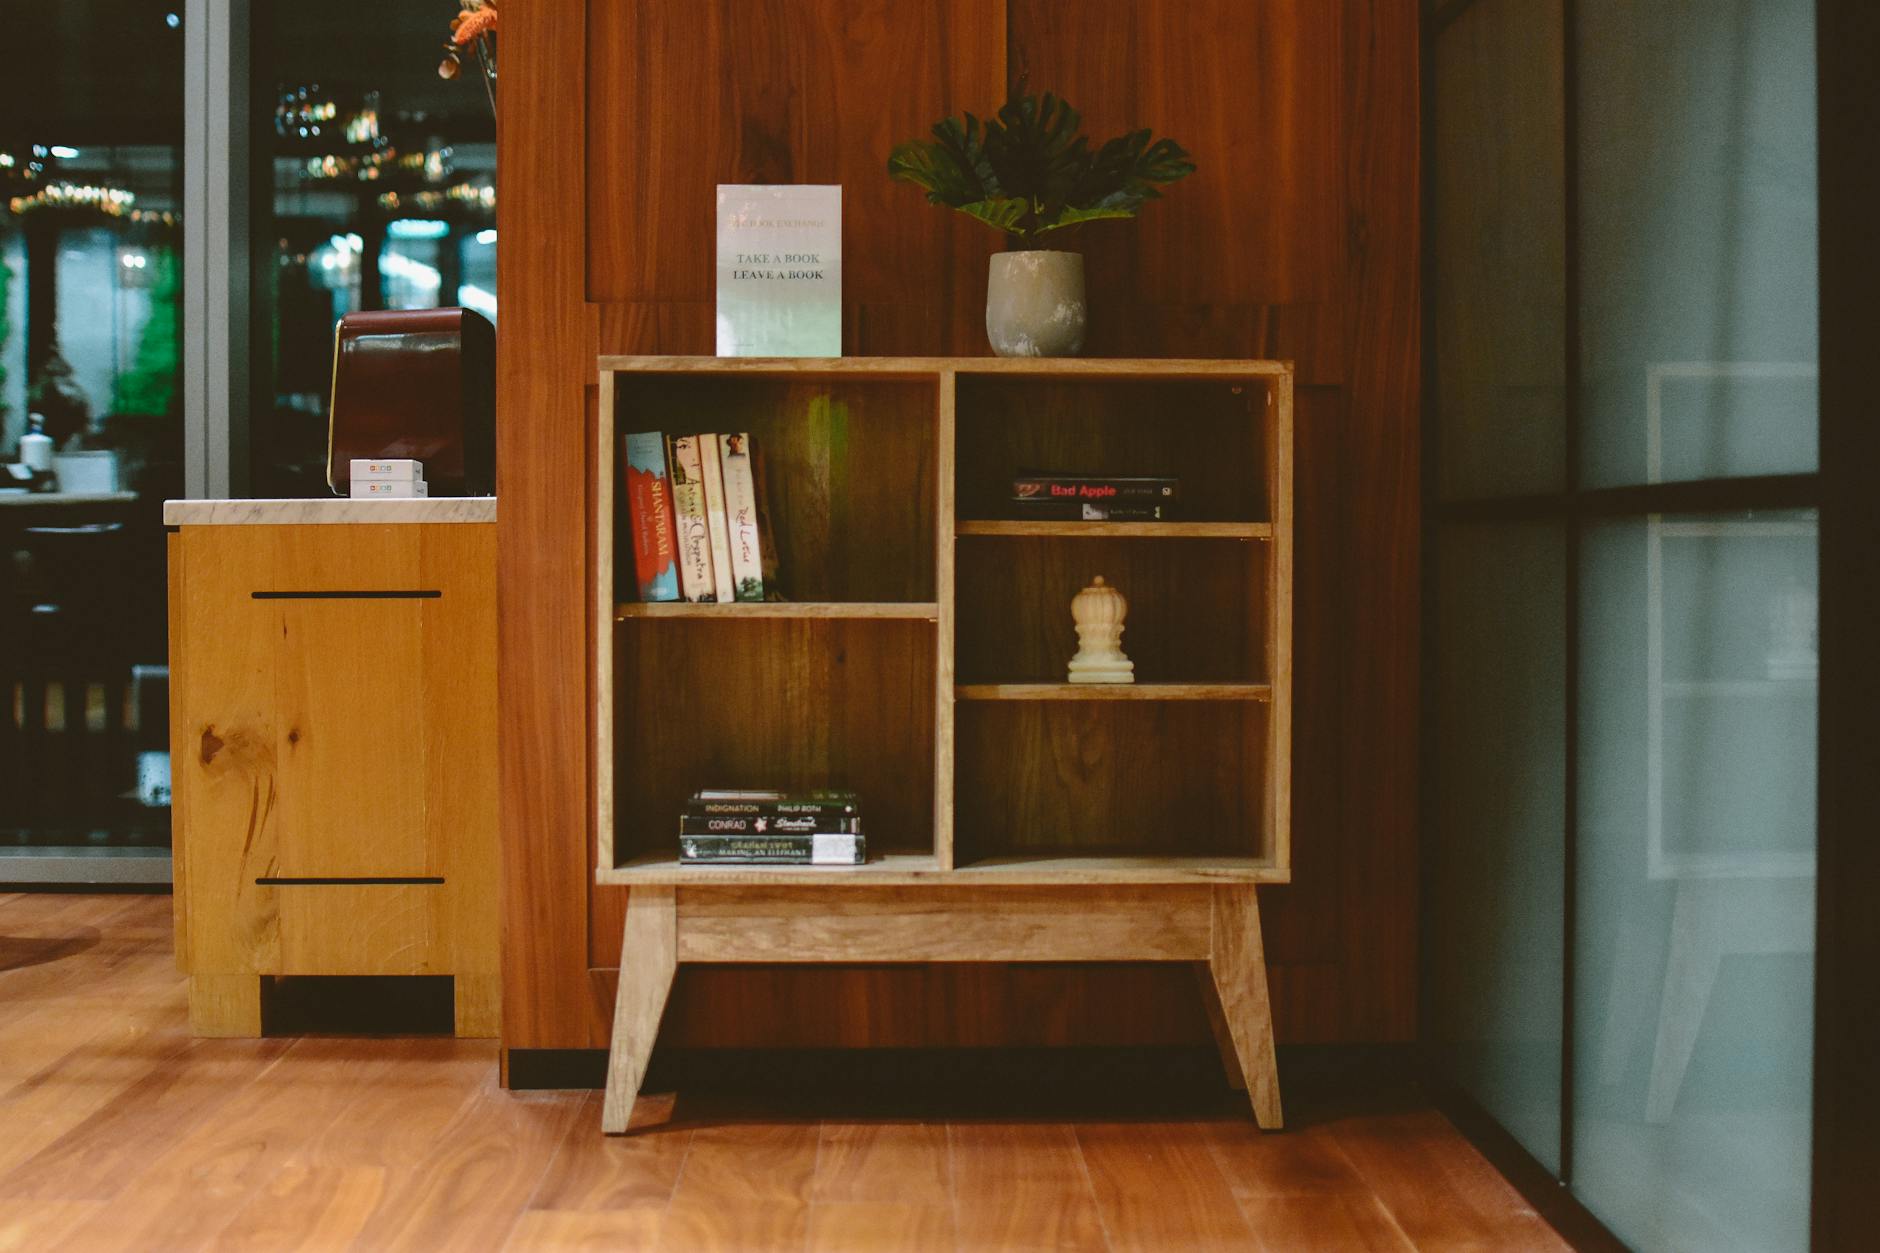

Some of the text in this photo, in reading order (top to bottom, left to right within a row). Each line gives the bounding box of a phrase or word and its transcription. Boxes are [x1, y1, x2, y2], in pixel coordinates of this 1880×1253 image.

[737, 254, 820, 264] TAKE A BOOK
[733, 270, 824, 280] LEAVE A BOOK
[1051, 485, 1076, 496] Bad
[1079, 485, 1117, 497] Apple
[652, 481, 668, 556] SHANTARAM
[736, 507, 752, 528] Red
[738, 529, 752, 563] Lotus
[705, 804, 760, 813] INDIGNATION
[777, 804, 822, 813] PHILIP ROTH
[708, 820, 747, 831] CONRAD
